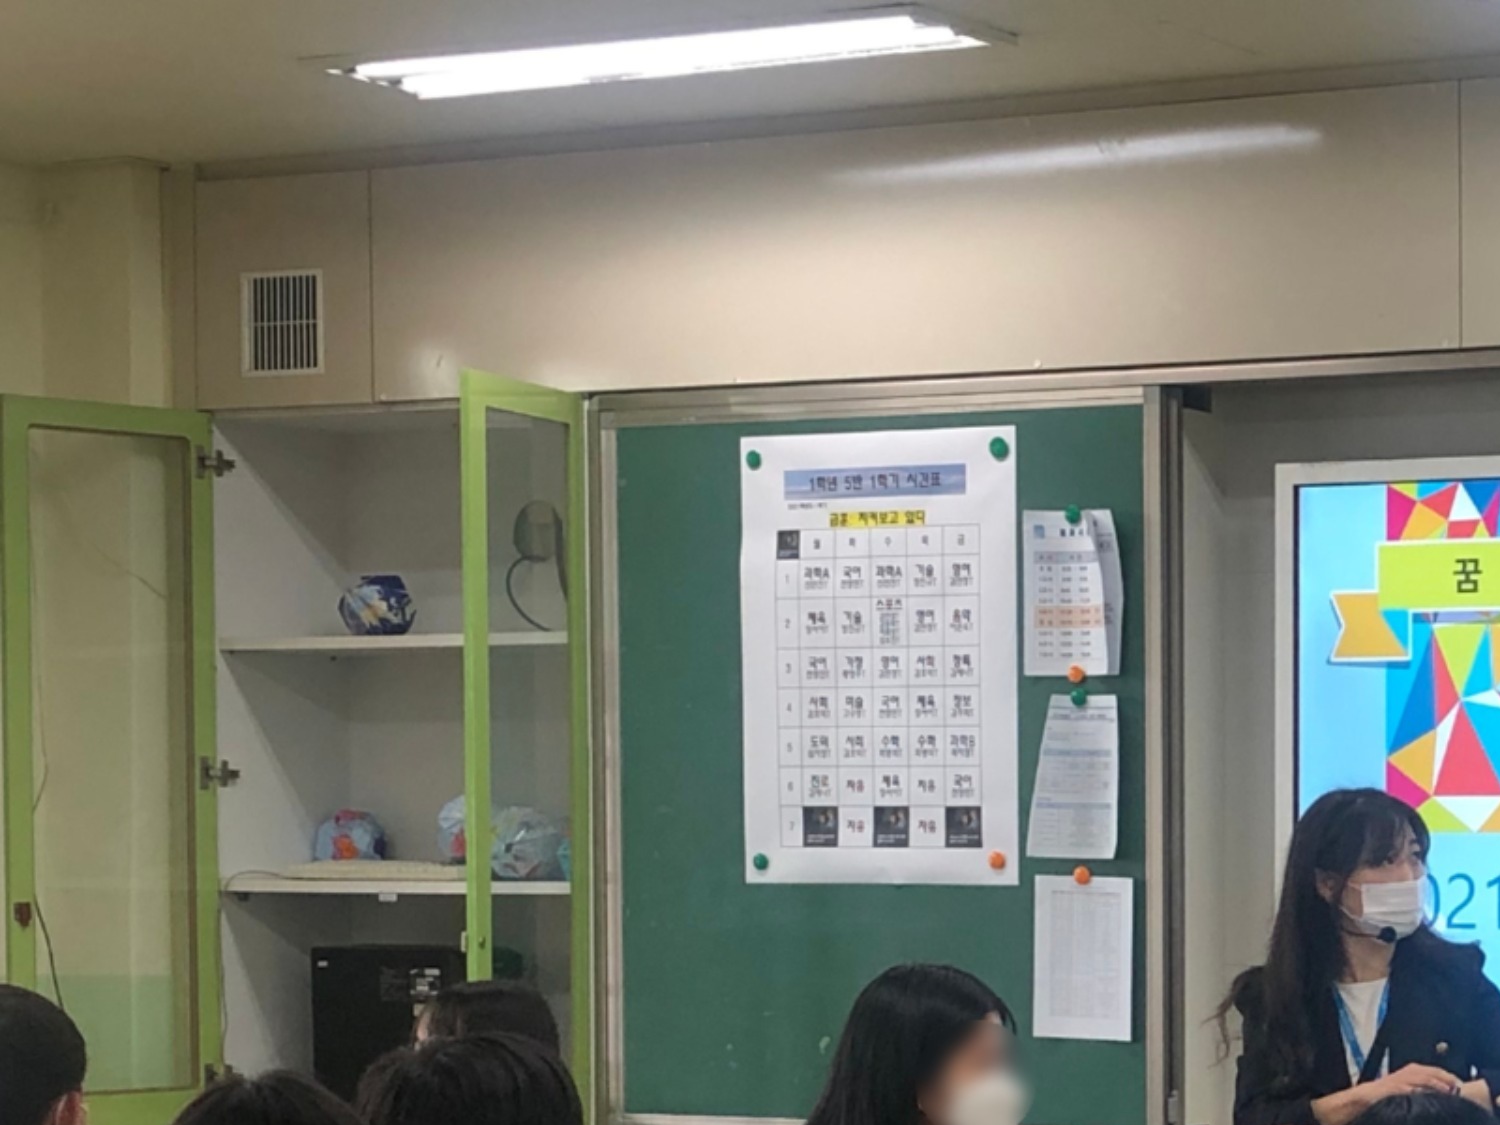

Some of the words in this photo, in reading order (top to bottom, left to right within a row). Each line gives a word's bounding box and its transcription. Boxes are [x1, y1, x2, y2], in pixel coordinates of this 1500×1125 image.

[809, 475, 837, 492] 1학년
[844, 474, 863, 490] 5반
[870, 473, 899, 489] 1학기
[906, 472, 941, 488] 시간표
[803, 566, 830, 579] 과학A
[843, 566, 862, 579] 국어
[875, 565, 903, 579] 과학A
[915, 564, 935, 577] 기술
[952, 563, 971, 577] 영어
[1452, 558, 1483, 593] 꿈
[808, 611, 827, 625] 체육
[843, 611, 862, 625] 기술
[916, 609, 935, 624] 영어
[809, 656, 828, 669] 국어
[845, 656, 864, 670] 가정
[880, 656, 900, 670] 영어
[916, 655, 935, 668] 사회
[809, 696, 828, 709] 사회
[845, 696, 864, 709] 미술
[881, 696, 900, 709] 국어
[917, 695, 935, 708] 체육
[953, 694, 972, 708] 정보
[845, 735, 864, 748] 사회
[881, 735, 900, 748] 수학
[917, 735, 936, 748] 수학
[882, 774, 900, 788] 체육
[953, 774, 972, 788] 국어
